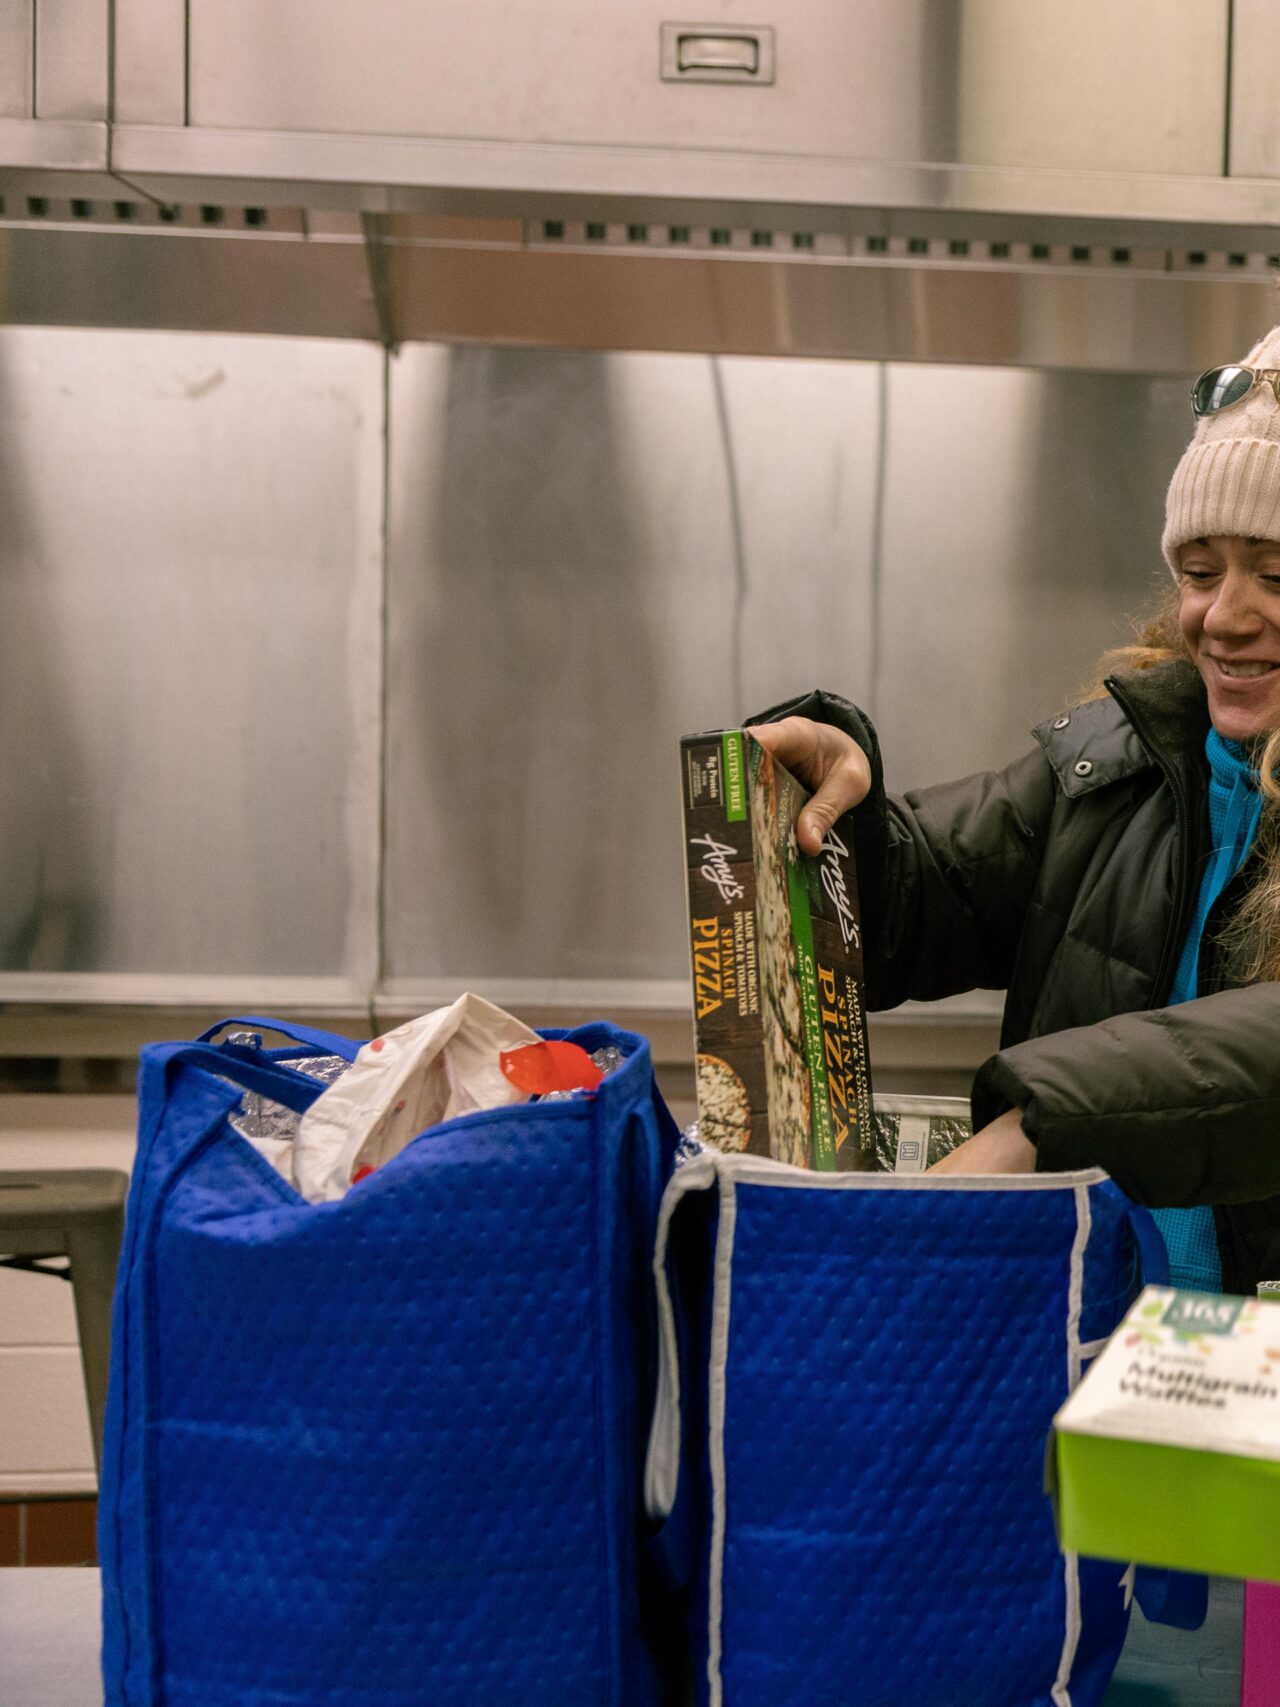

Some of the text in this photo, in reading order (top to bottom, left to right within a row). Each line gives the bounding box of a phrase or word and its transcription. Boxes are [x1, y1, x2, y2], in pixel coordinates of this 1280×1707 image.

[709, 770, 718, 798] Protein
[727, 738, 741, 813] GLUTEN FREE
[690, 833, 744, 899] Amy's
[820, 829, 859, 950] Amy's
[693, 916, 723, 1019] PIZZA
[721, 928, 737, 999] SPINACH
[733, 911, 748, 1016] SPINACH & TOMATOES
[744, 911, 759, 1015] MADE WITH ORGANIC
[804, 955, 831, 1152] GLUTEN FREE
[818, 962, 849, 1154] PIZZA
[837, 995, 858, 1125] SPINACH
[845, 975, 866, 1150] SPINACH & TOMATOES
[851, 980, 871, 1149] MADE WITH ORGANIC
[1118, 1378, 1228, 1409] Waffles
[1128, 1360, 1279, 1399] Multigrain
